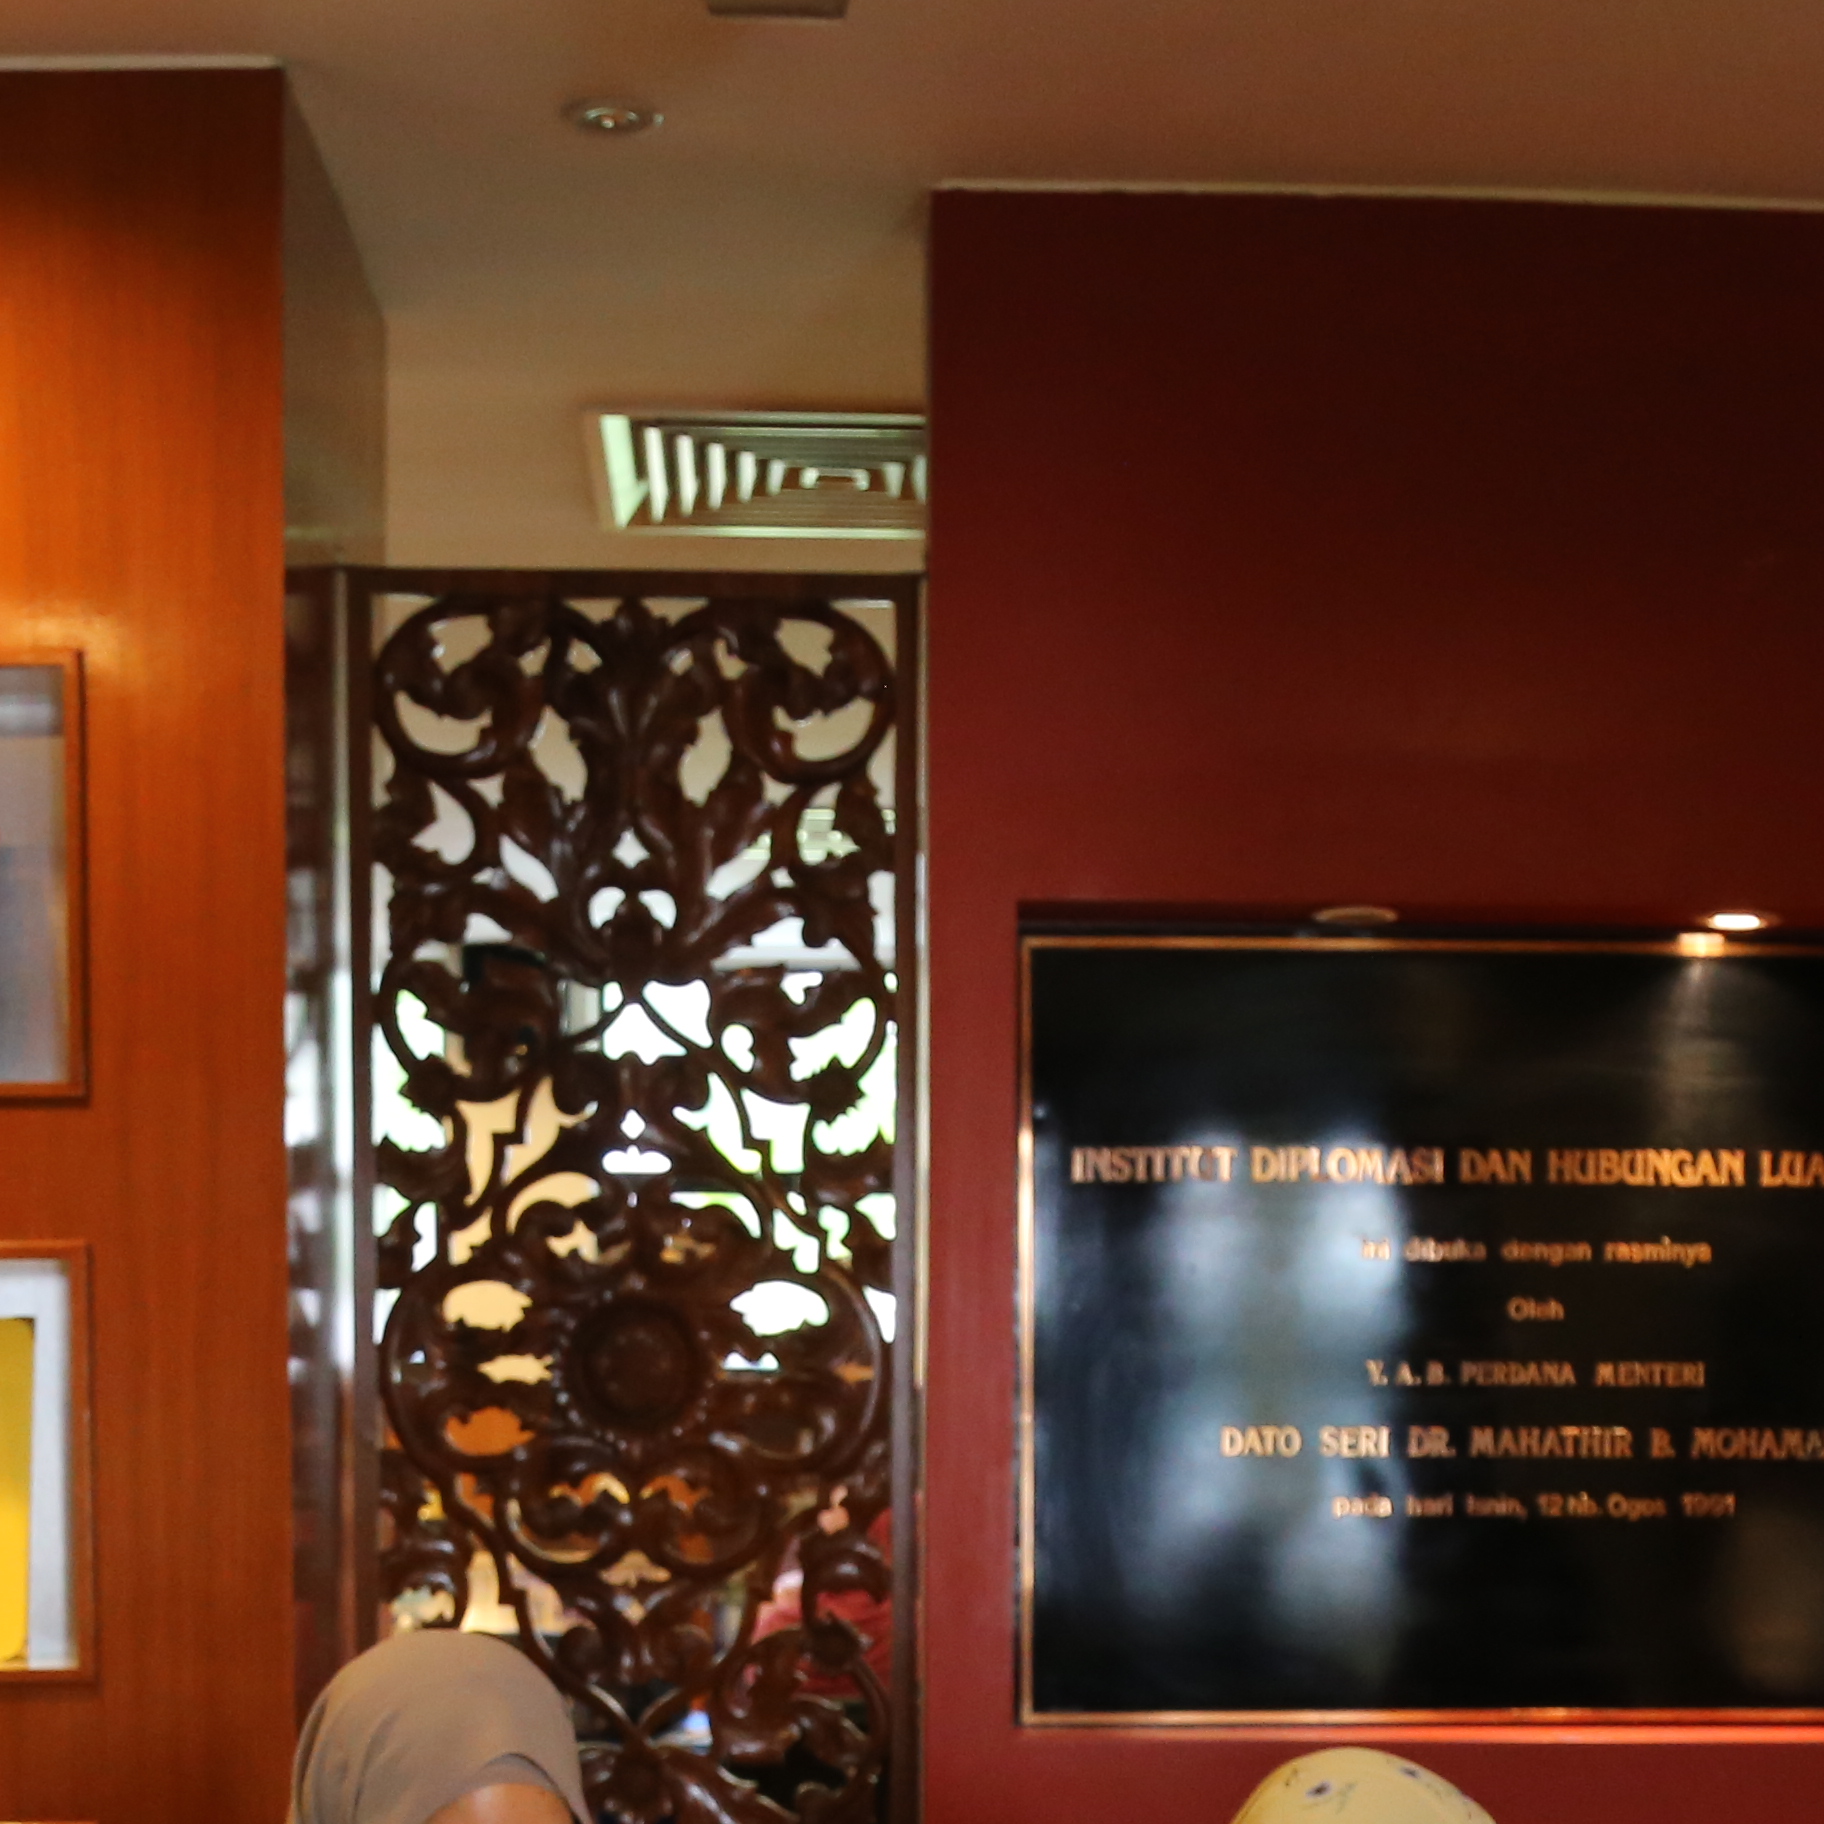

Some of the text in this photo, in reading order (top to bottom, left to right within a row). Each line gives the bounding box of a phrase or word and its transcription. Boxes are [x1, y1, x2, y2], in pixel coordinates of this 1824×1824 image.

[1070, 1146, 1238, 1183] INSTITUT
[1250, 1146, 1444, 1184] DIPLOMASI
[1459, 1148, 1532, 1184] DAN
[1547, 1148, 1745, 1187] HUBUNGAN
[1501, 1238, 1591, 1267] dengan
[1506, 1298, 1564, 1321] Oleh
[1460, 1361, 1576, 1387] PERDANA
[1595, 1361, 1705, 1388] MENTERI
[1220, 1425, 1303, 1458] DATO
[1319, 1425, 1391, 1458] SERI
[1408, 1425, 1456, 1458] DR.
[1471, 1425, 1633, 1458] MAHATHIR
[1332, 1494, 1394, 1519] pada
